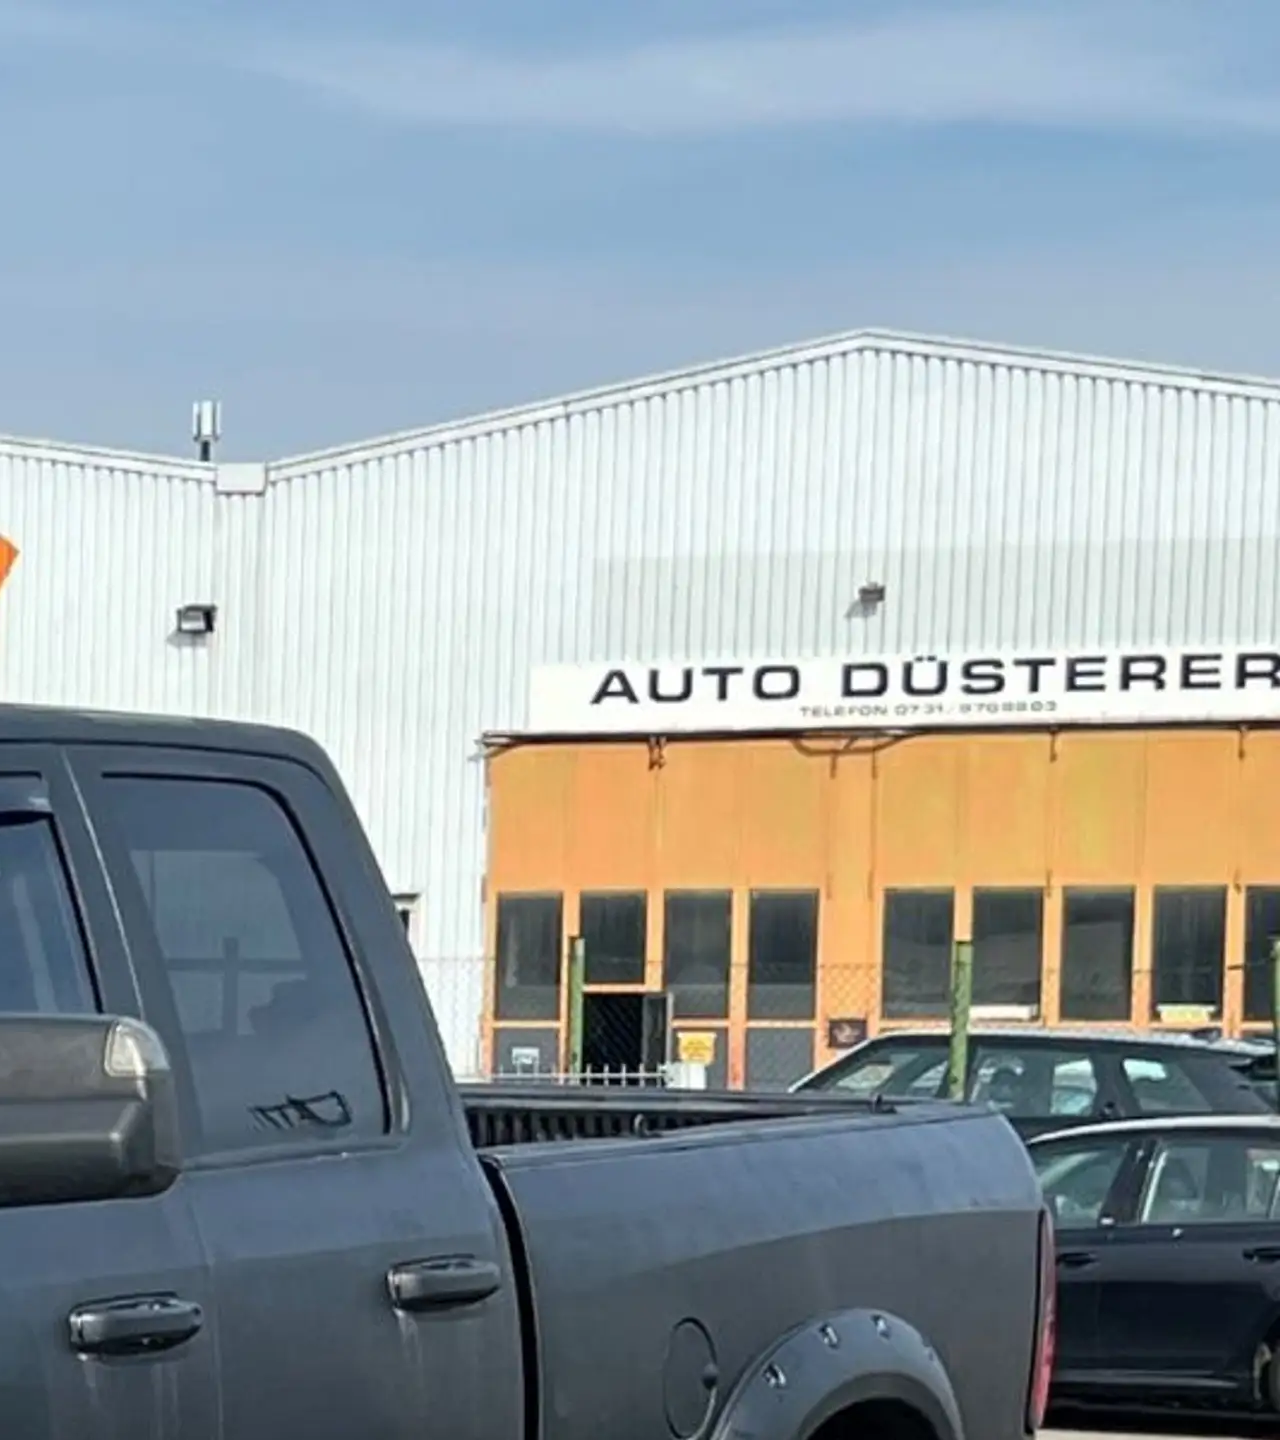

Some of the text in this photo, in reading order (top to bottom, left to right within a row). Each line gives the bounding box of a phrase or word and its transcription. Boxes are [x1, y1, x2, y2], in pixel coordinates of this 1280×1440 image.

[591, 653, 1280, 705] AUTO DÜSTERER
[799, 703, 889, 718] TELEFON
